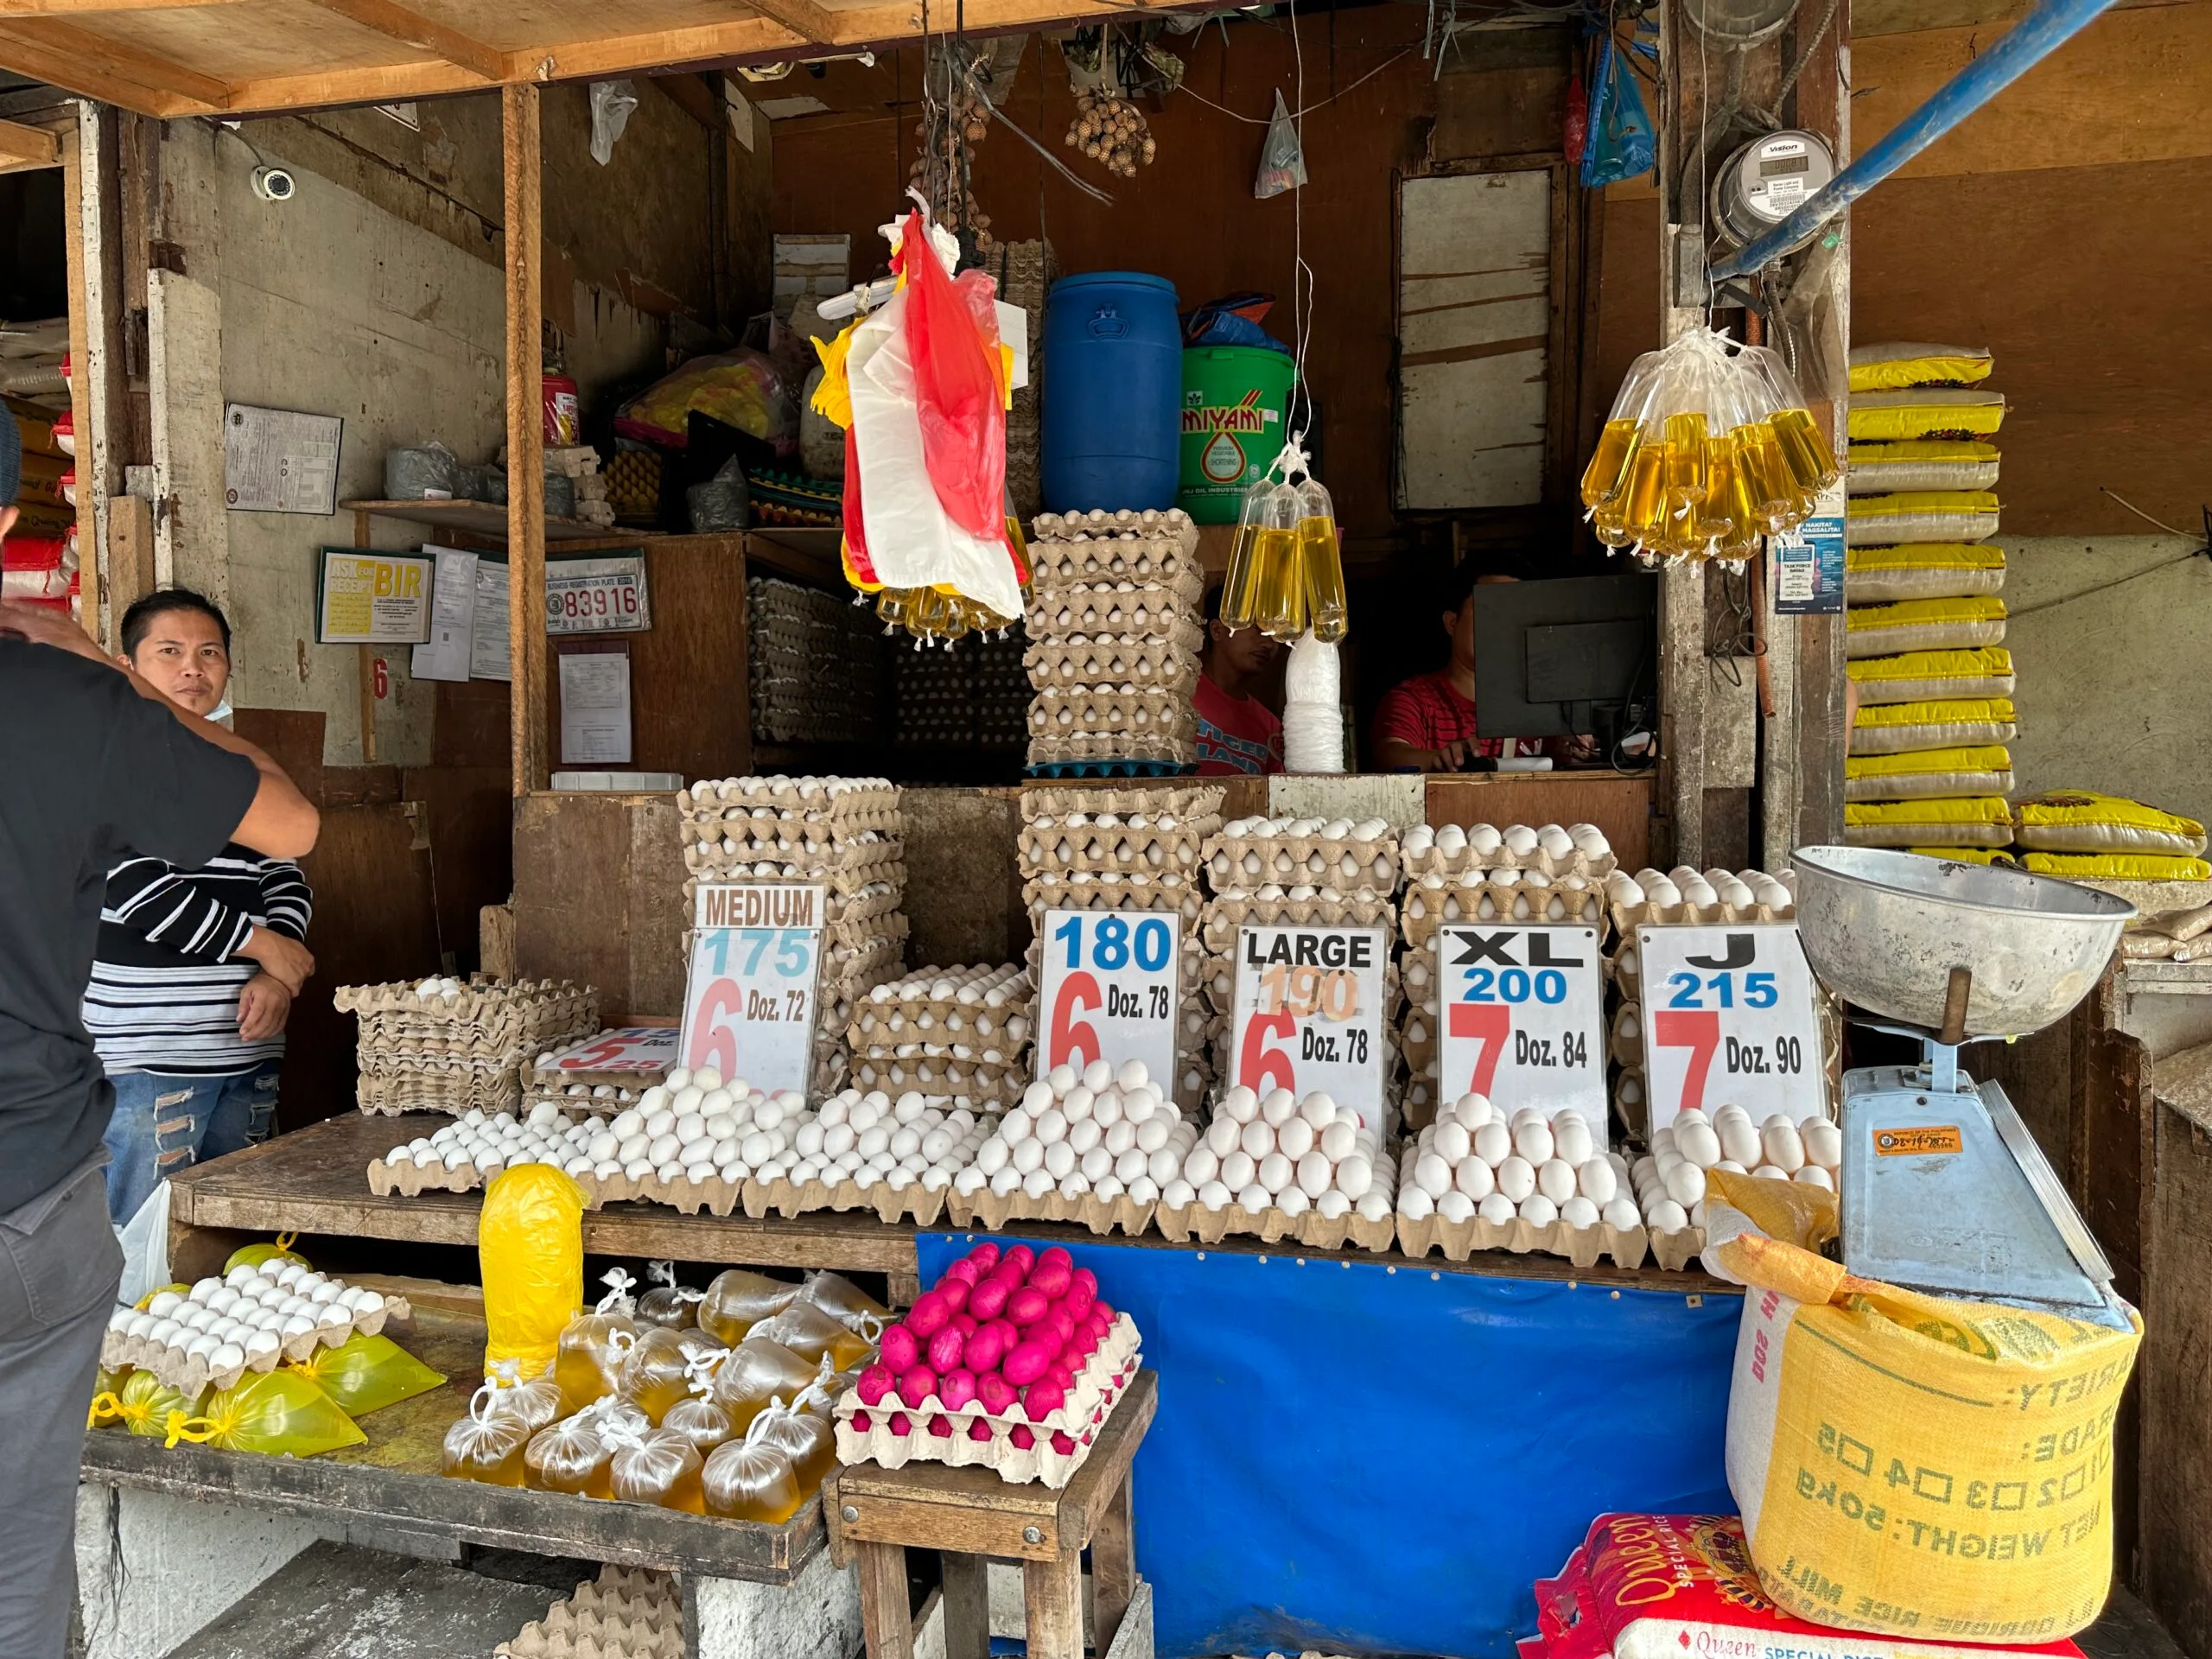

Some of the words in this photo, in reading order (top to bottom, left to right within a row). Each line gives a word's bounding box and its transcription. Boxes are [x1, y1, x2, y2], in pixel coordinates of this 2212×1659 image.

[1181, 407, 1265, 434] MIYAMI
[329, 579, 374, 594] RECEIPT
[373, 563, 422, 599] BIR
[601, 578, 615, 587] PLATE
[564, 587, 637, 618] 83916
[373, 658, 388, 700] 6
[705, 889, 814, 927] MEDIUM
[704, 929, 810, 978] 175
[1055, 916, 1172, 972] 180
[1247, 933, 1371, 968] LARGE
[1449, 931, 1584, 968] XL
[1685, 933, 1756, 969] J
[1108, 983, 1143, 1018] Doz.
[1149, 985, 1169, 1020] 78
[1259, 963, 1359, 1022] 190
[1463, 968, 1567, 1004] 200
[1668, 972, 1778, 1008] 215
[747, 989, 779, 1022] Doz.
[785, 989, 805, 1022] 72
[1049, 971, 1103, 1073] 6
[688, 977, 743, 1086] 6
[1302, 1027, 1340, 1063] Doz.
[1346, 1028, 1368, 1064] 78
[1516, 1029, 1557, 1067] Doz.
[1563, 1031, 1587, 1068] 84
[1239, 1007, 1296, 1099] 6
[1449, 1003, 1510, 1100] 7
[1655, 1011, 1720, 1113] 7
[1726, 1036, 1770, 1074] Doz.
[1776, 1035, 1802, 1074] 90
[1651, 1516, 1673, 1533] RICE
[1608, 1516, 1693, 1606] Queen
[1663, 1536, 1694, 1588] SPECIAL
[1696, 1630, 1758, 1659] Queen
